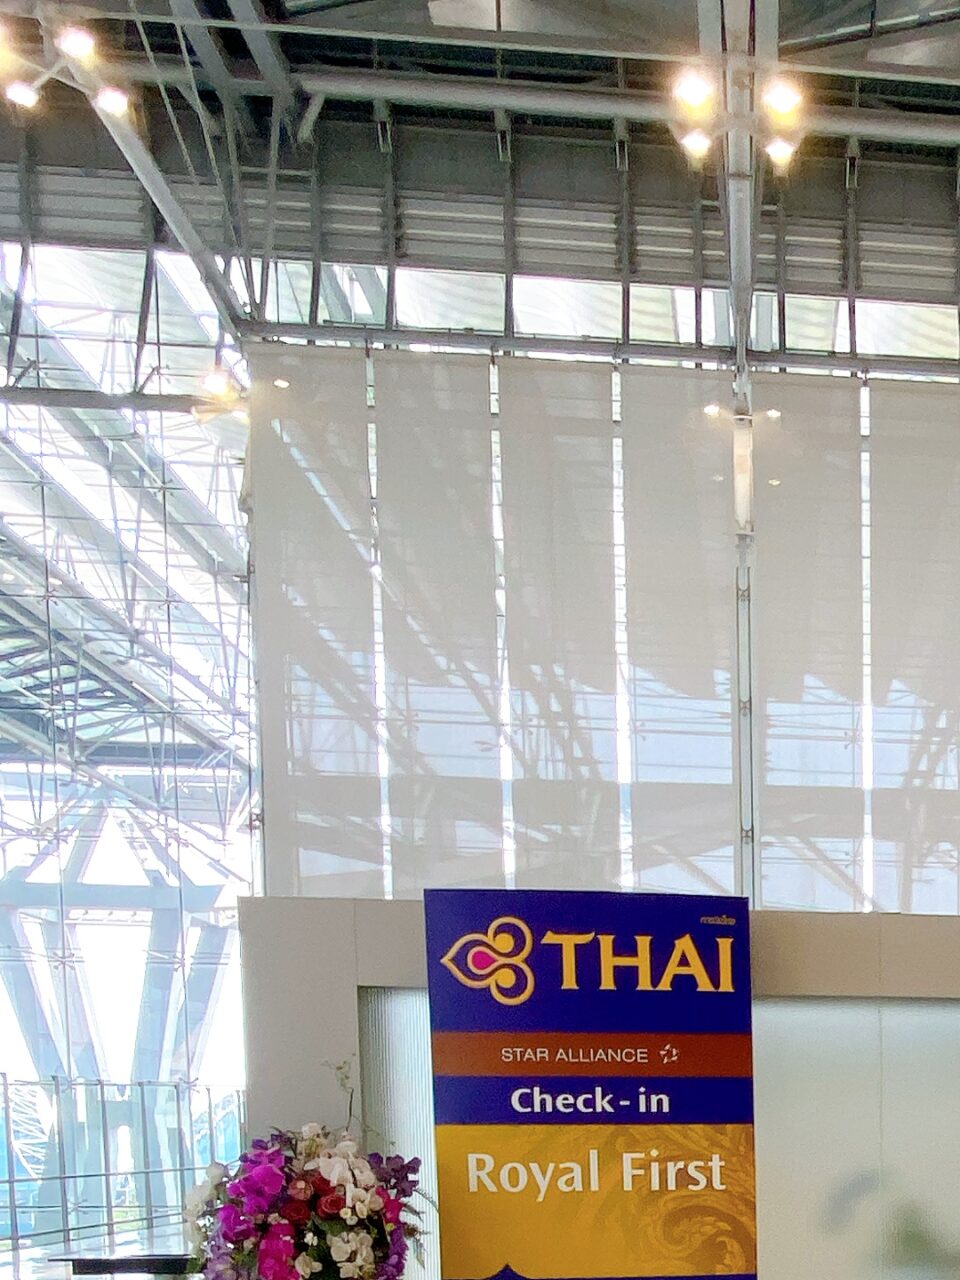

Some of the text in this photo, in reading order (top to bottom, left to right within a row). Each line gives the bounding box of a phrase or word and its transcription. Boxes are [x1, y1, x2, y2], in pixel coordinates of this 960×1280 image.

[540, 930, 735, 993] THAI
[501, 1047, 649, 1063] STAR ALLIANCE
[467, 1148, 727, 1202] Royal First
